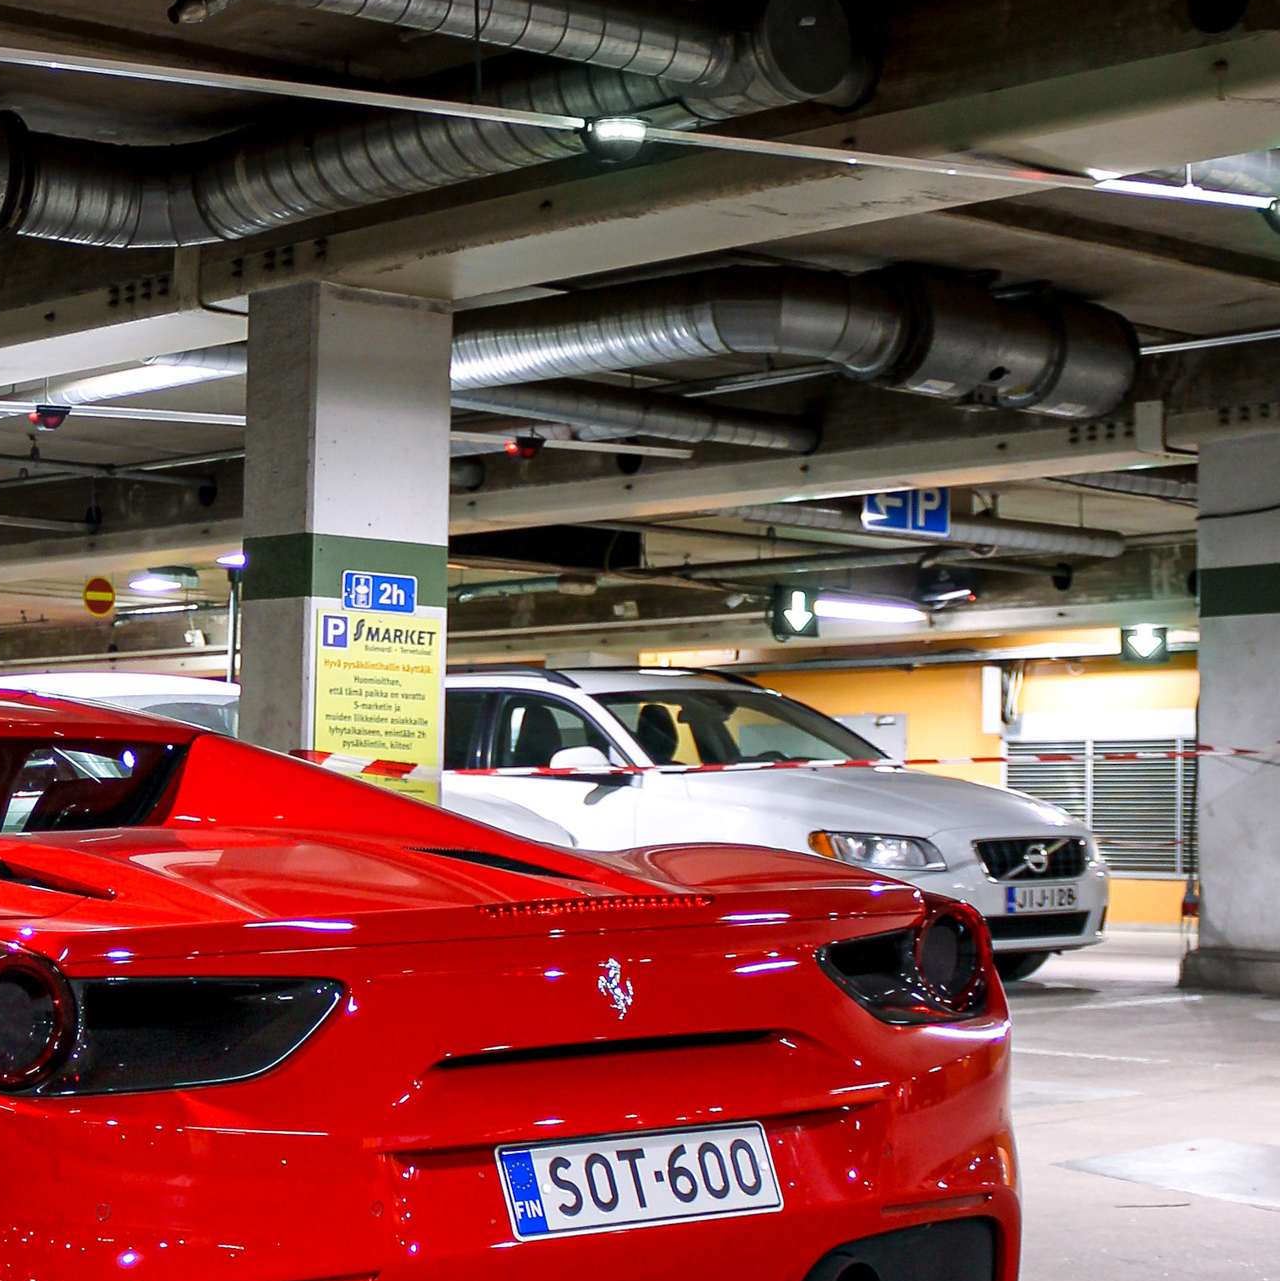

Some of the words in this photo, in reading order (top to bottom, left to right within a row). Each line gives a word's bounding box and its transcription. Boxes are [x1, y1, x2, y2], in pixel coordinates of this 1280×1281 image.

[917, 488, 941, 527] P
[378, 582, 405, 606] 2h
[327, 617, 346, 645] P
[365, 626, 437, 646] MARKET
[365, 689, 388, 698] paikka
[394, 703, 401, 713] ja
[417, 731, 426, 739] 2h
[515, 1200, 544, 1220] FIN
[549, 1138, 763, 1217] SOT-600
